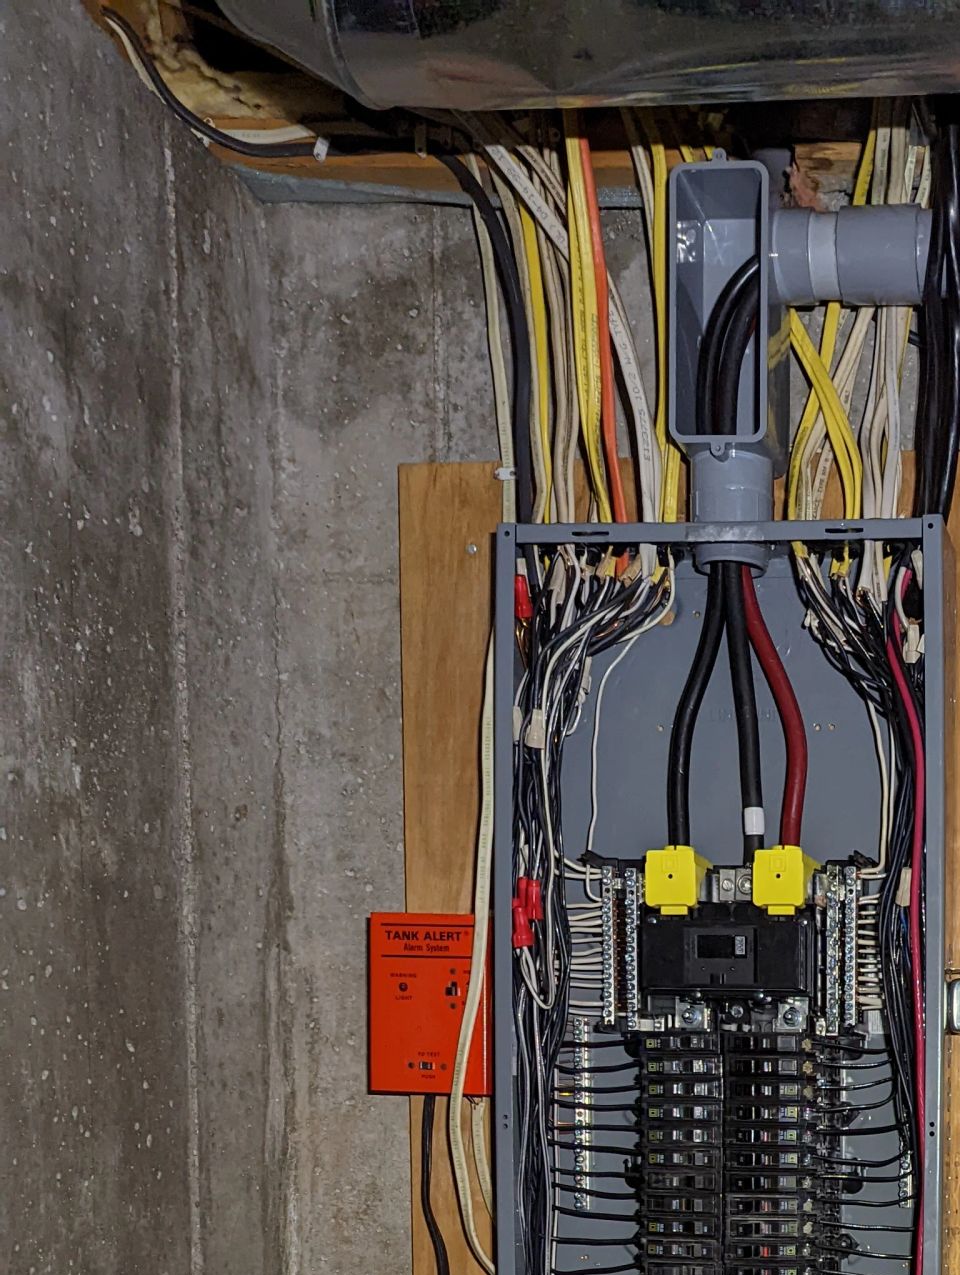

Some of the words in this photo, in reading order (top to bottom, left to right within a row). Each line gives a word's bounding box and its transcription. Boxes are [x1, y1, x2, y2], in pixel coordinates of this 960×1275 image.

[385, 930, 419, 941] TANK
[423, 931, 462, 942] ALERT
[403, 943, 423, 952] Alarm
[426, 943, 450, 953] System
